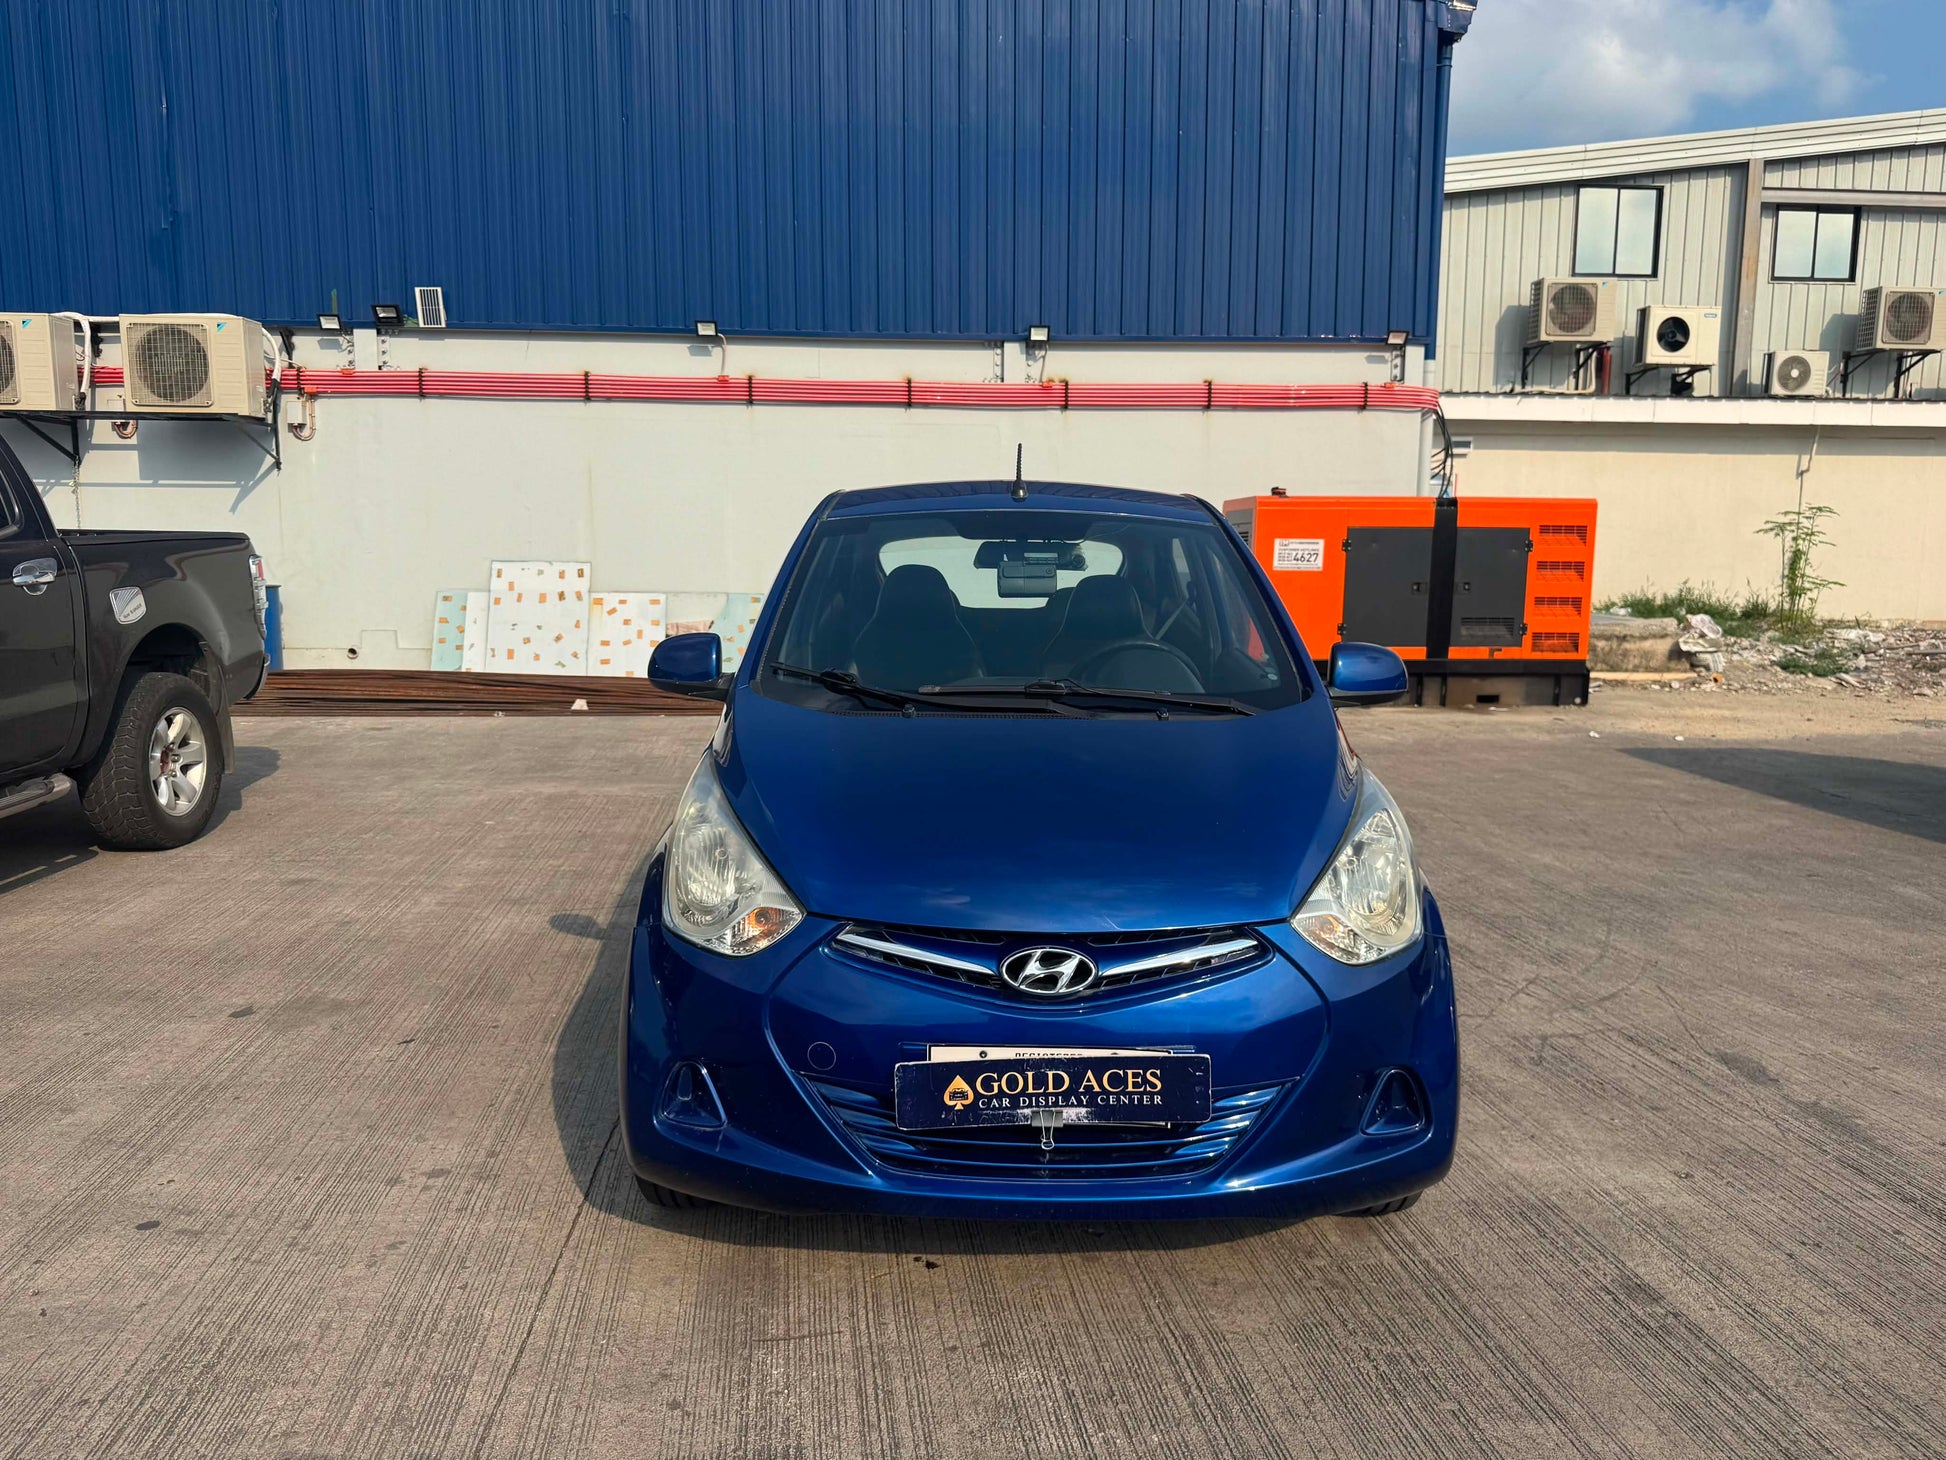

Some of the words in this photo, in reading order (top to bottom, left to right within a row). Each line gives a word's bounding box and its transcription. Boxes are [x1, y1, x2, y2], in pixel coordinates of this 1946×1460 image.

[1292, 552, 1319, 563] 4627
[975, 1070, 1070, 1096] GOLD
[1078, 1068, 1162, 1093] ACES
[978, 1097, 1011, 1109] CAR
[1020, 1095, 1090, 1107] DISPLAY
[1097, 1094, 1163, 1105] CENTER
